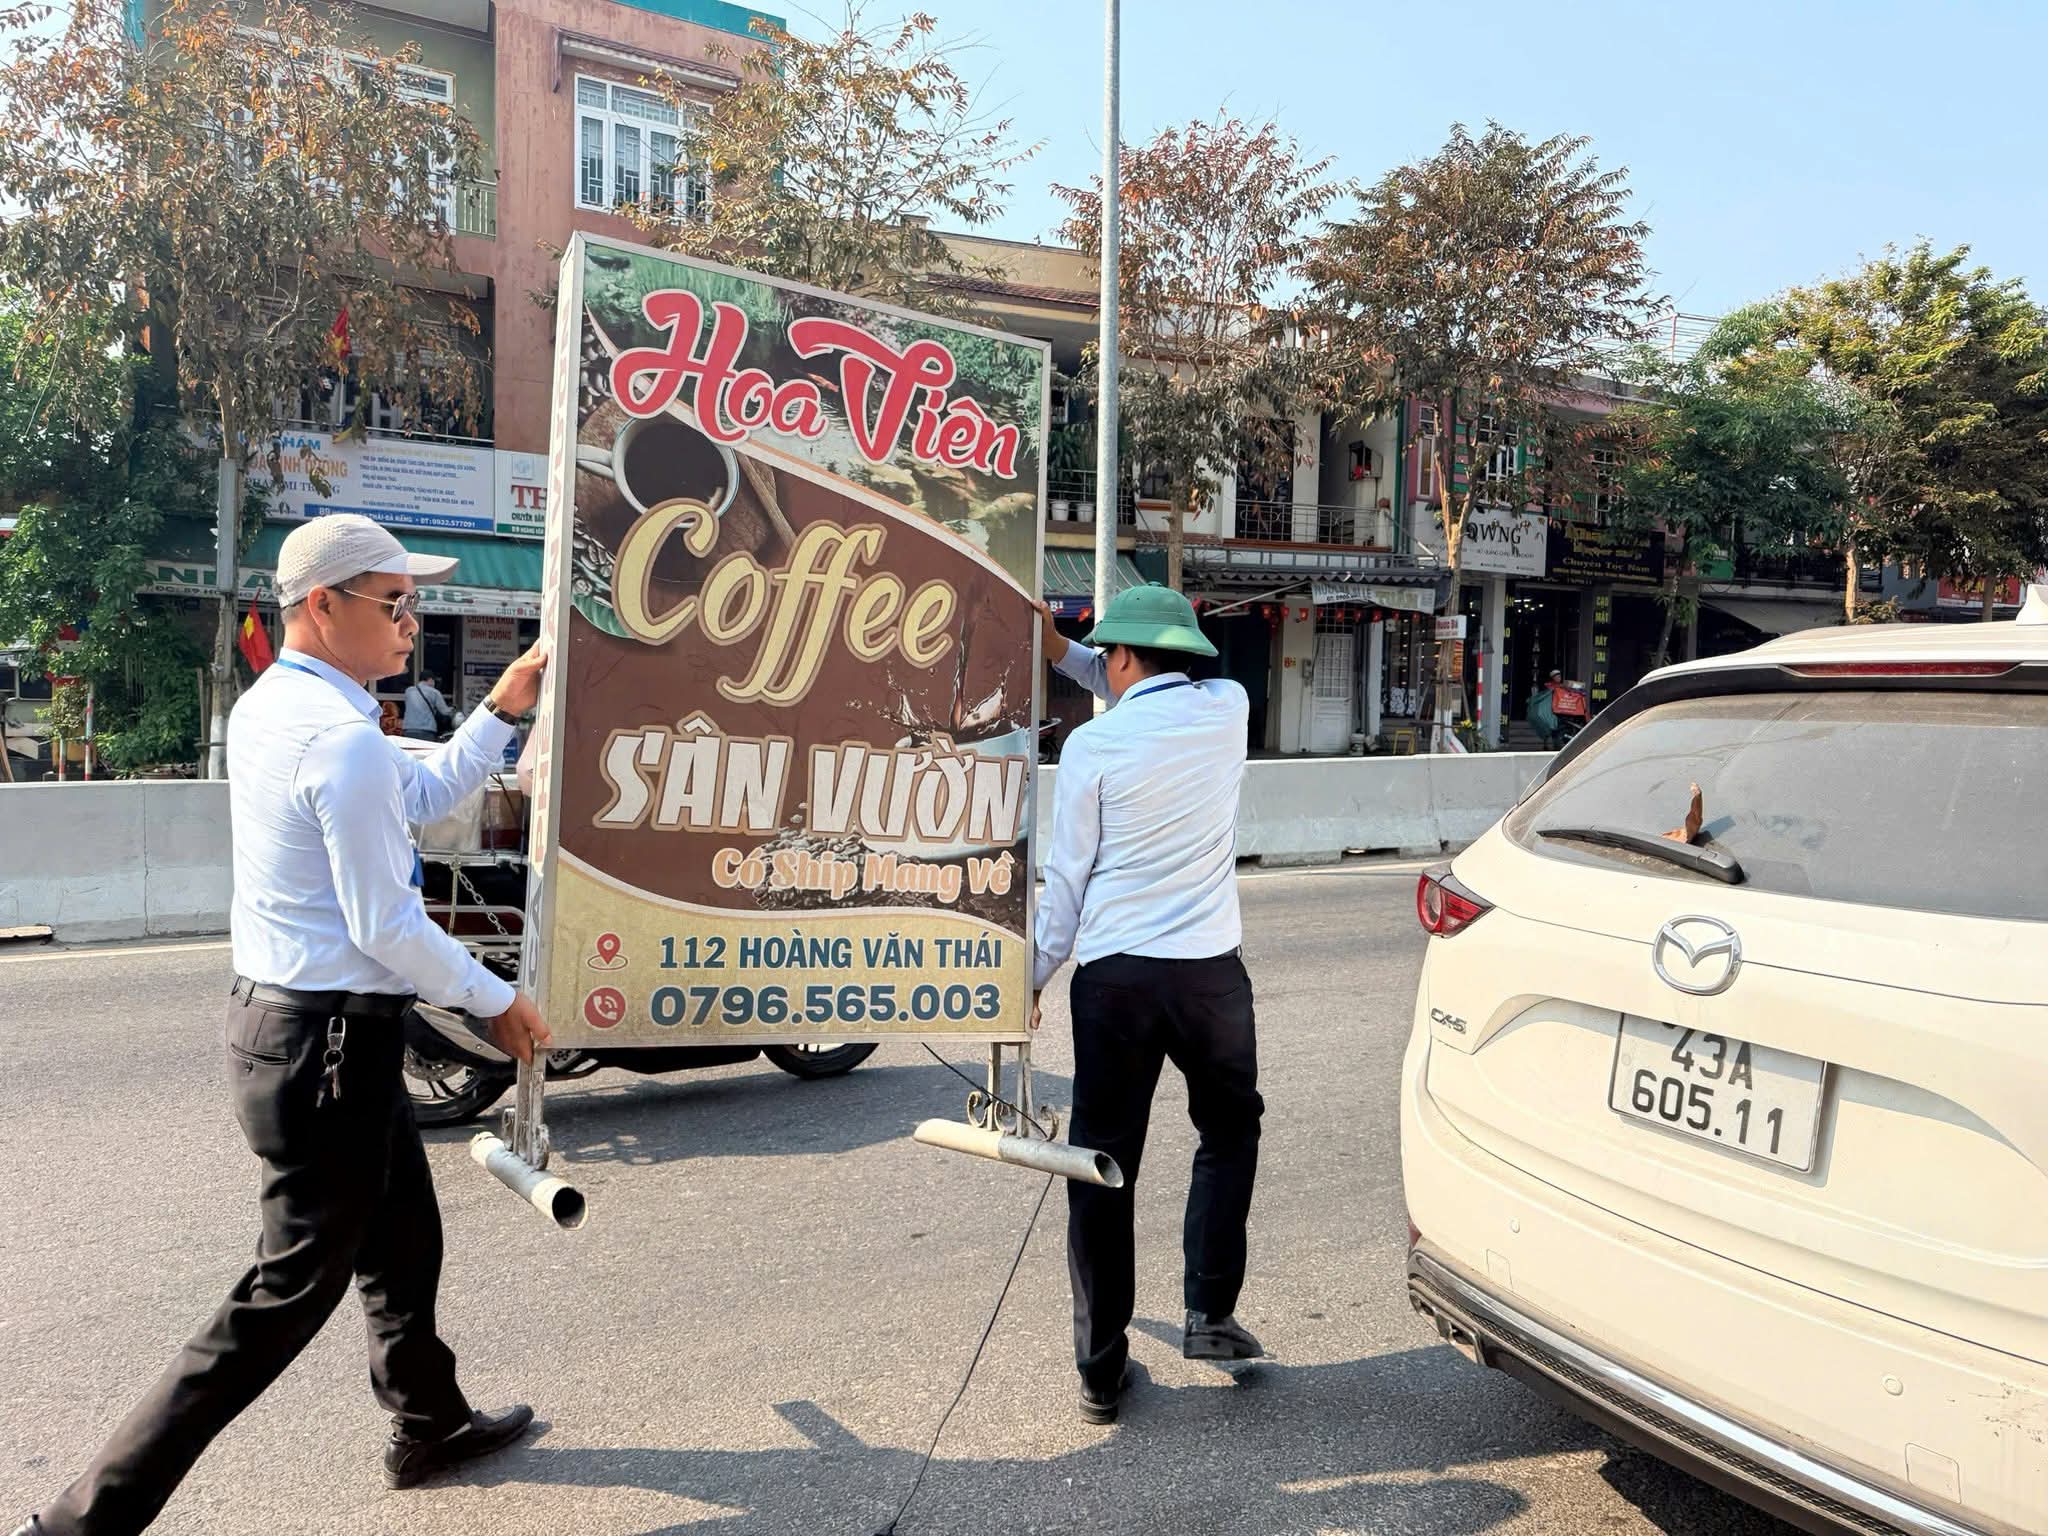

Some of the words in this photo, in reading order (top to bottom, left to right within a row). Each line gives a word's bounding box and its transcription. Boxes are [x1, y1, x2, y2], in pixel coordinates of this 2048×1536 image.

[610, 289, 827, 442] Hoa
[788, 317, 1018, 479] Viên
[611, 497, 957, 707] Coffee
[594, 710, 794, 834] SÂN
[807, 733, 1027, 848] VƯỜN
[712, 847, 766, 889] Có
[771, 848, 857, 900] Ship
[862, 852, 963, 903] Mang
[968, 849, 1016, 896] Về
[659, 935, 727, 970] 112
[738, 928, 853, 969] HOÀNG
[862, 932, 922, 969] VĂN
[933, 931, 1003, 969] THÁI
[650, 983, 1002, 1027] 0796.565.003
[1670, 1024, 1754, 1091] 43A
[1632, 1069, 1785, 1155] 605.11
